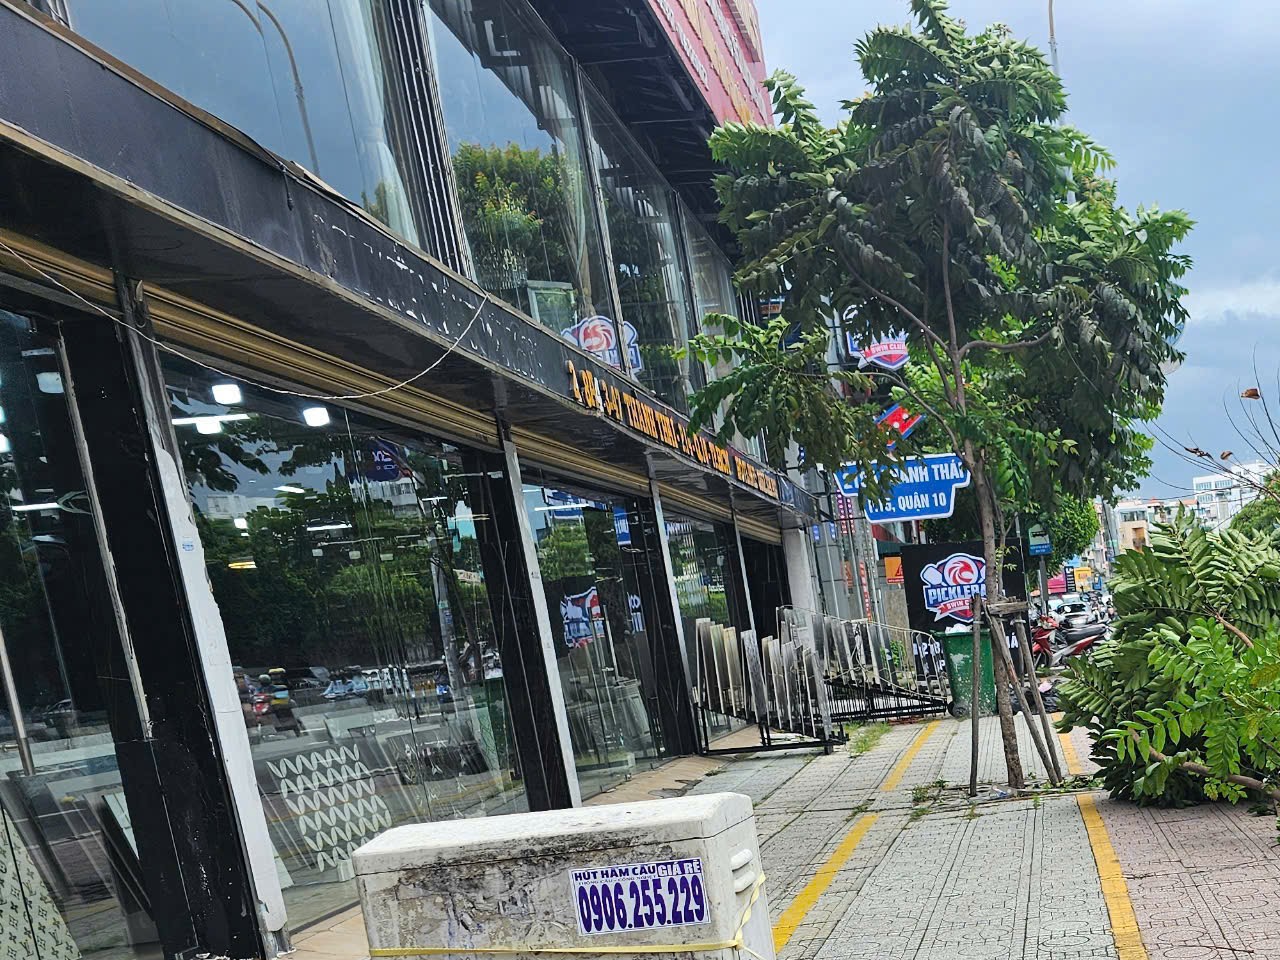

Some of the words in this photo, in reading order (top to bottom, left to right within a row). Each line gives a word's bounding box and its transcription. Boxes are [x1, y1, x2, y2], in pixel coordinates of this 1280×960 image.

[898, 492, 930, 512] QUẬN
[932, 491, 947, 507] 10
[928, 583, 987, 604] PICKLEBA
[658, 862, 682, 877] GIÁ
[578, 875, 705, 933] 0906.255.229
